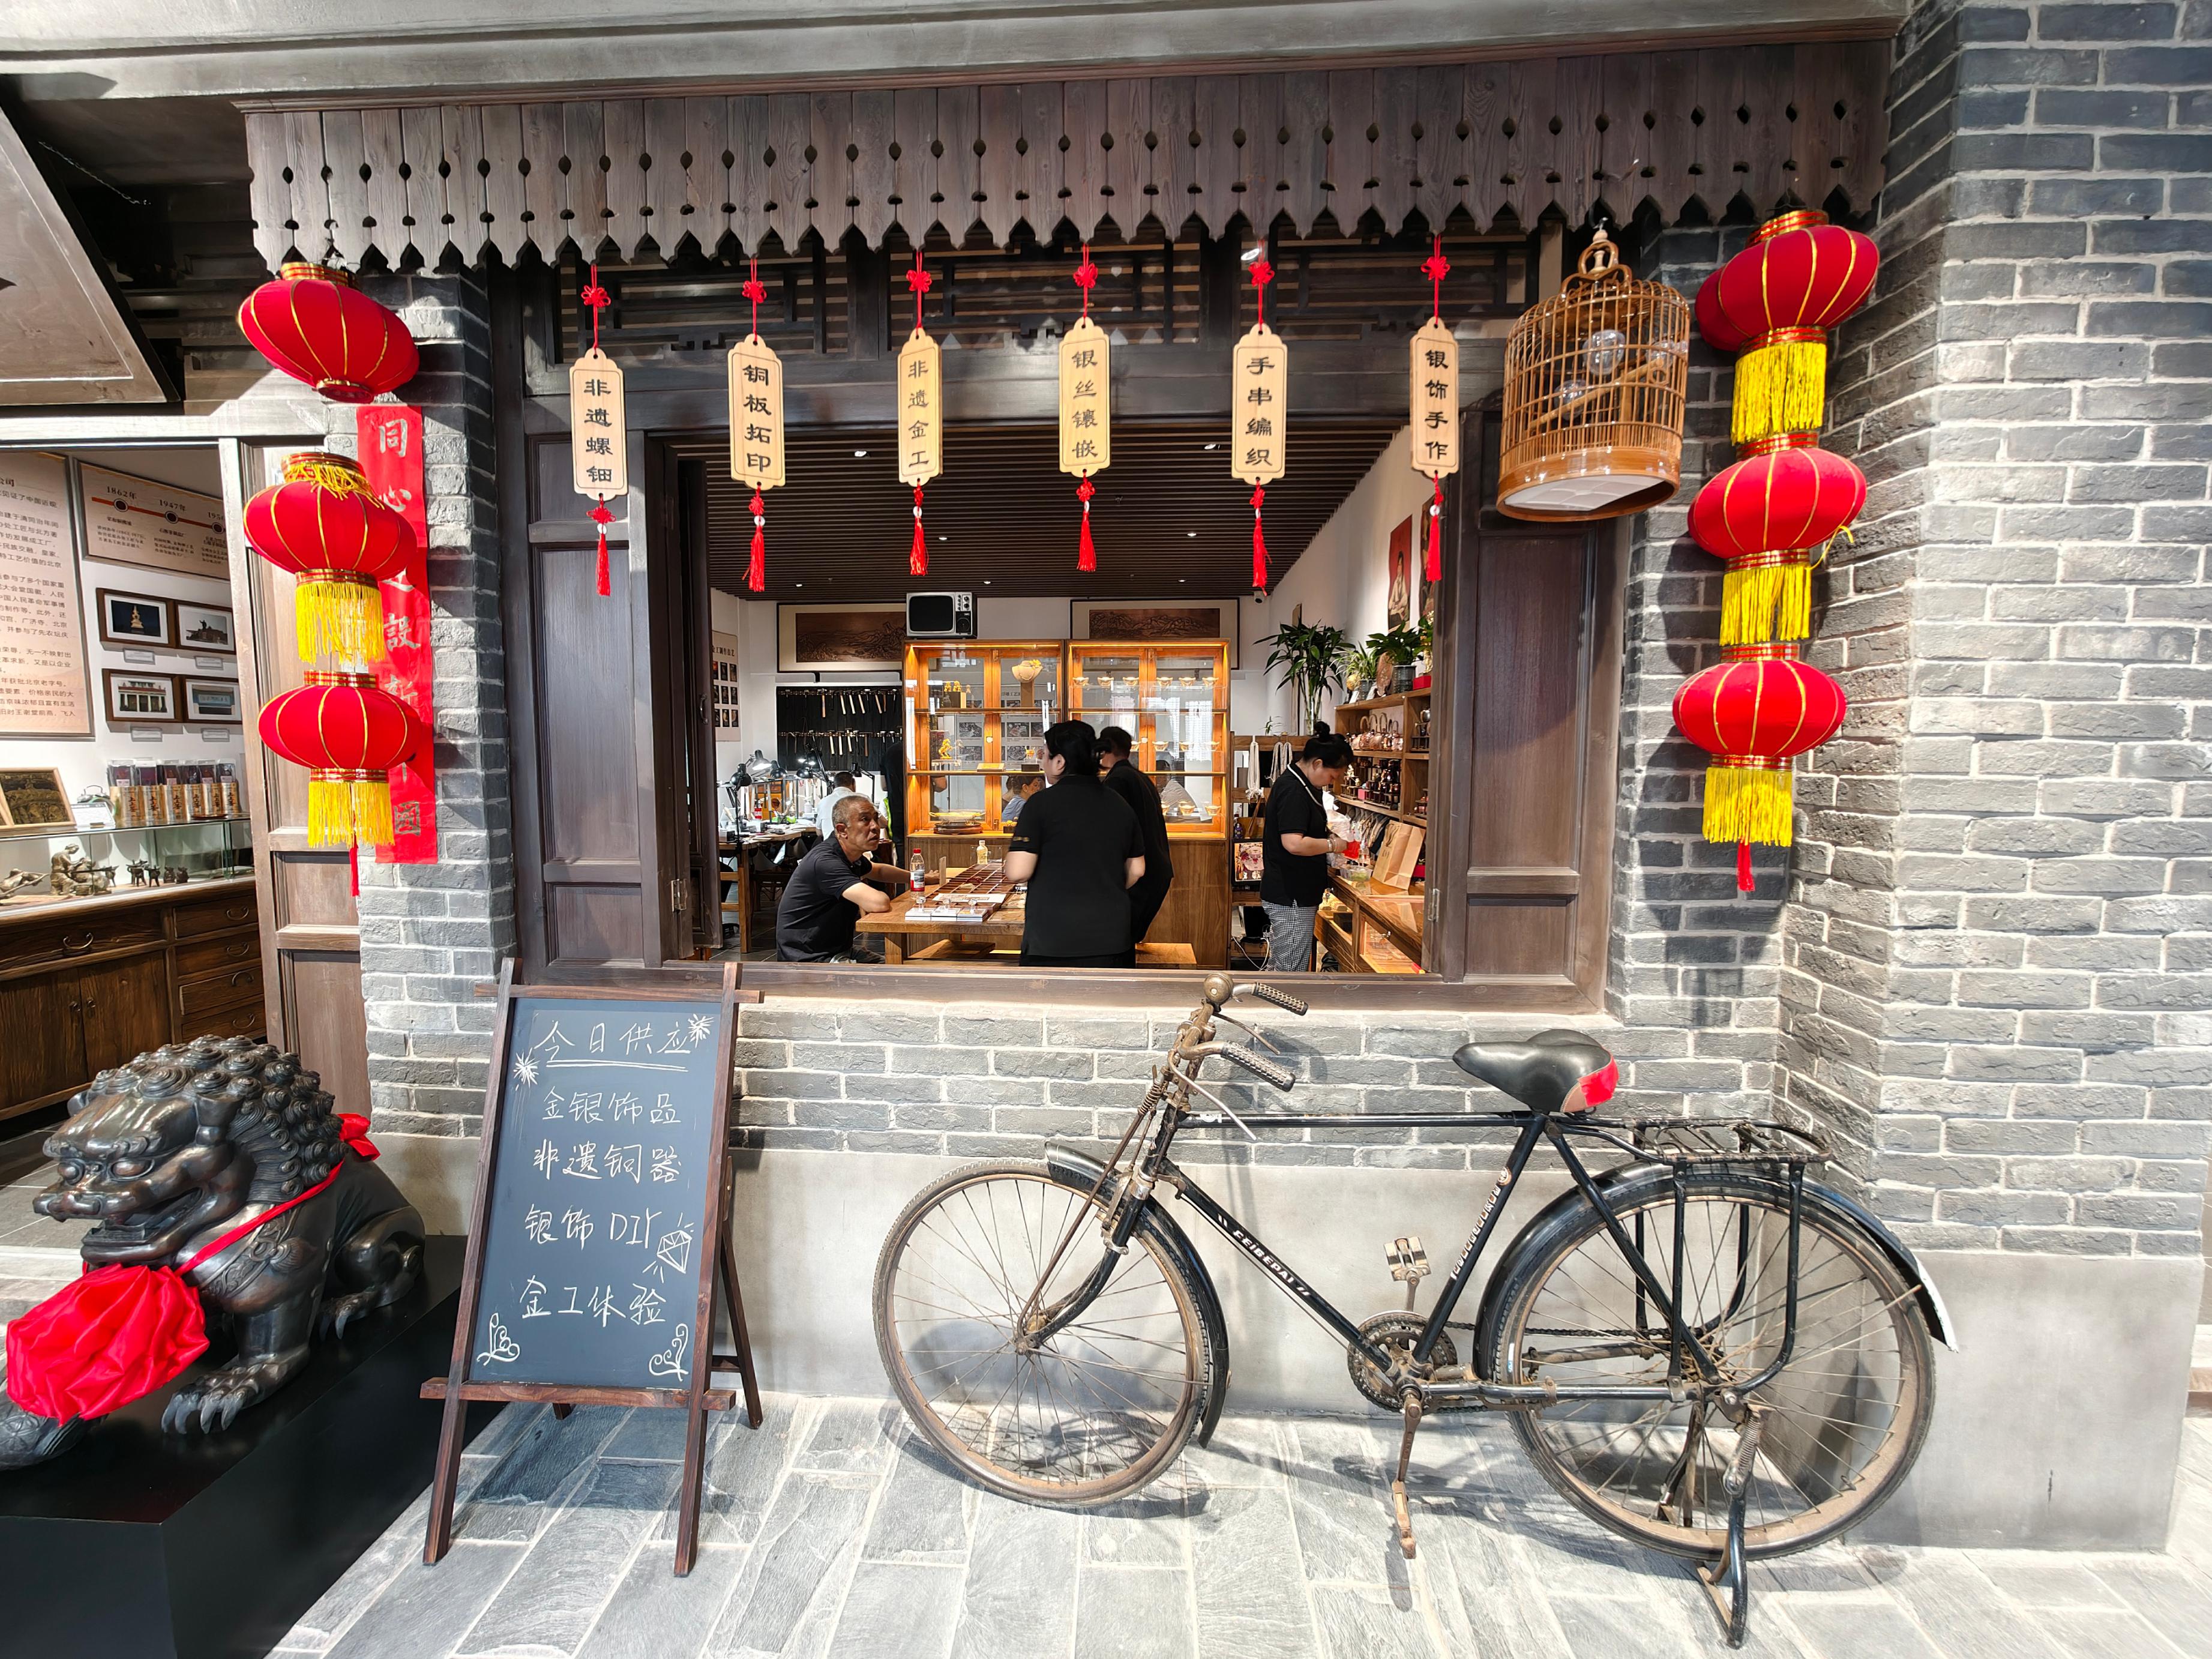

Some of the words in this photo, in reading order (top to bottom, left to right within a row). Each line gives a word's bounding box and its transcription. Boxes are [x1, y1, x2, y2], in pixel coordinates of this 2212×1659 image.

[742, 364, 772, 472] 铜板拓印
[907, 360, 930, 468] 非遗金工
[1071, 349, 1098, 459] 银丝镶嵌
[1245, 357, 1275, 466] 手串编织
[1424, 349, 1449, 460] 银饰手作
[583, 378, 613, 483] 非遗螺钿
[0, 490, 58, 508] 见证了中国近现
[106, 486, 137, 499] 1862年
[159, 499, 185, 511] 1947年
[208, 512, 224, 520] 195
[0, 574, 64, 588] 参与了多个国家重
[378, 418, 421, 837] 同心設新國
[533, 1020, 691, 1061] 今日供应
[541, 1085, 682, 1125] 金银饰品
[533, 1138, 682, 1184] 非遗铜器
[524, 1203, 594, 1250] 银饰
[609, 1207, 662, 1249] DIY
[1233, 1229, 1295, 1284] FEIGEPAI
[520, 1274, 667, 1328] 金工体验
